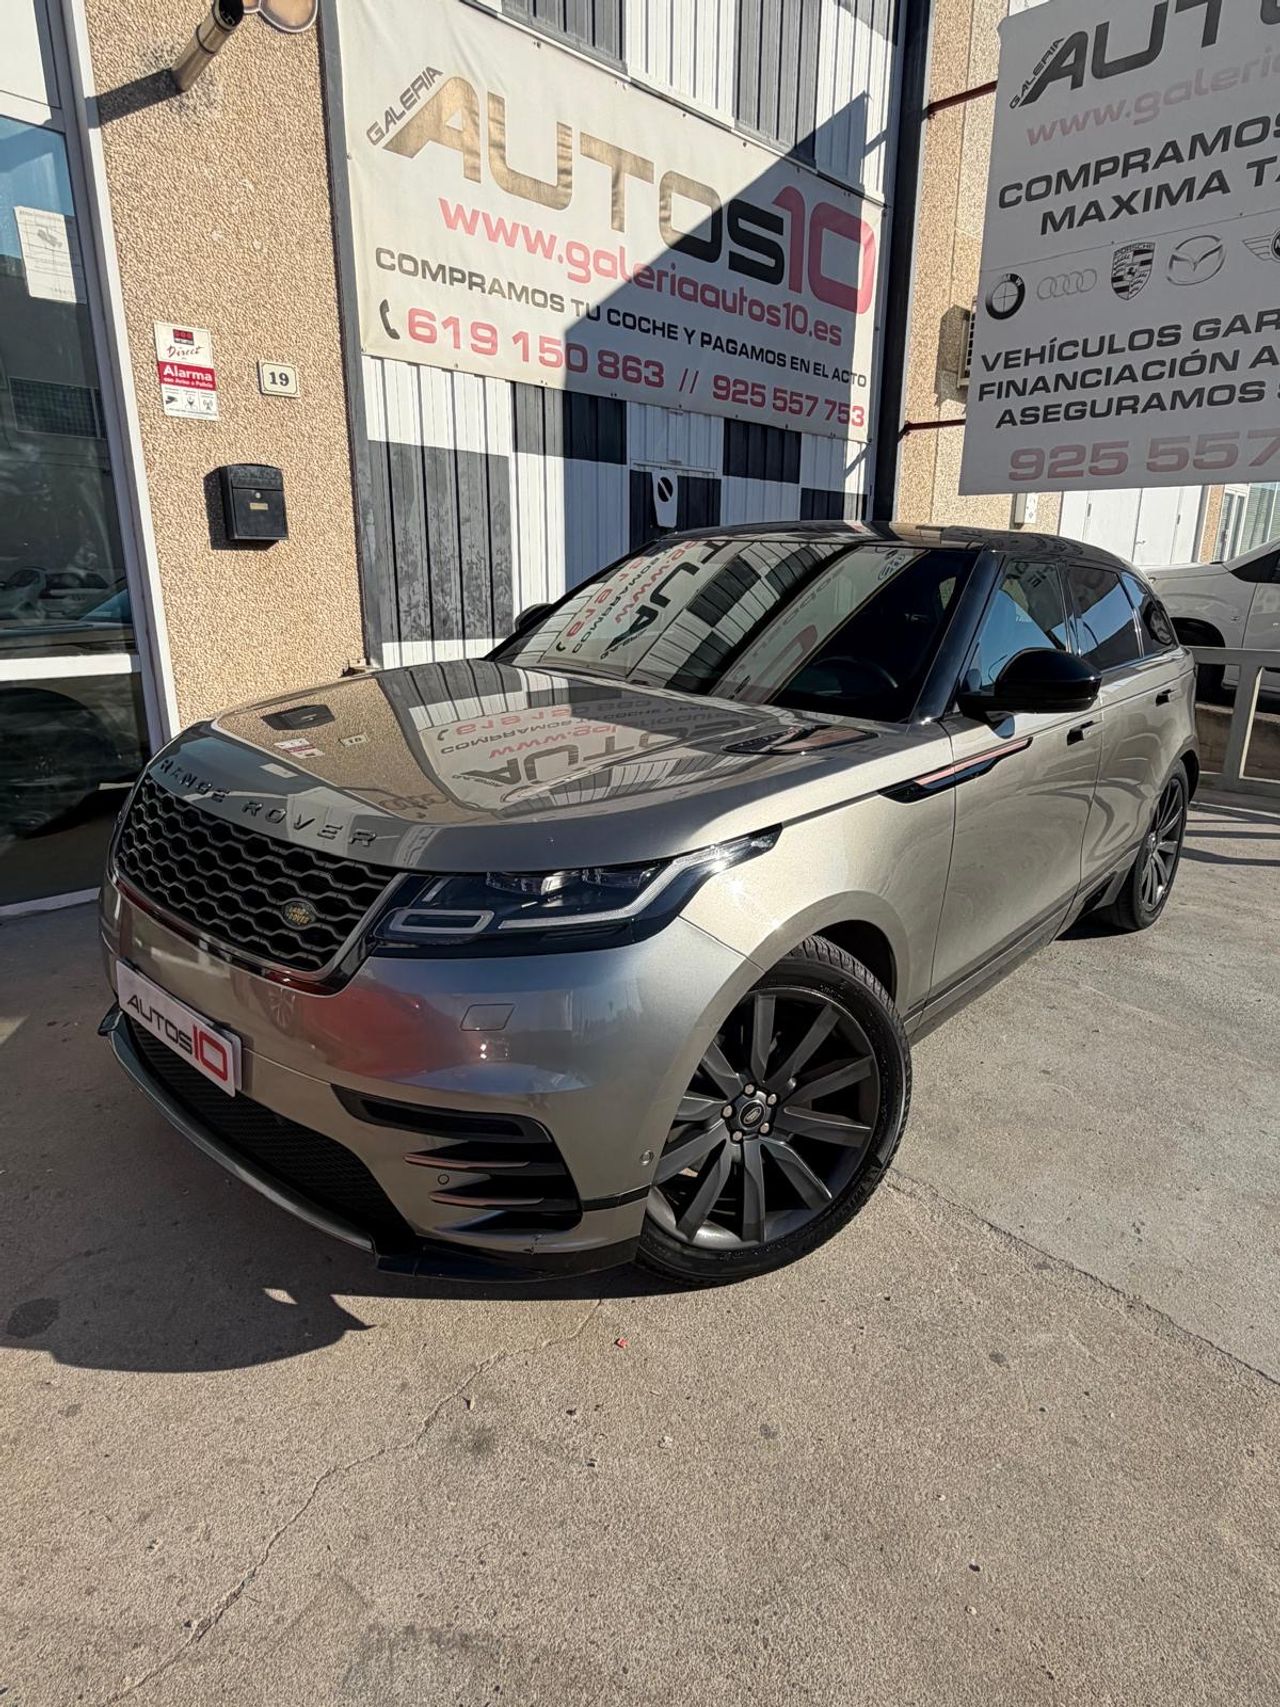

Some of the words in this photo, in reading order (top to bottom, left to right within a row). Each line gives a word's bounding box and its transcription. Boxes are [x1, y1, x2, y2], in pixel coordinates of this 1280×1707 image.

[1009, 37, 1065, 109] GALERIA
[1018, 0, 1280, 108] AUT
[366, 66, 443, 146] GALERIA
[1026, 46, 1280, 147] www.galeri
[998, 112, 1280, 209] COMPRAMO
[1040, 169, 1231, 236] MAXIMA
[1246, 155, 1280, 188] T
[438, 197, 842, 347] www.galeriaautos10.es
[167, 344, 204, 358] Direct
[375, 247, 565, 313] COMPRAMOS
[570, 298, 601, 322] TU
[606, 308, 679, 340] COCHE
[684, 328, 696, 345] Y
[700, 332, 787, 367] PAGAMOS
[790, 355, 810, 374] EN
[813, 362, 829, 378] EL
[831, 368, 868, 388] ACTO
[981, 324, 1182, 372] VEHÍCULOS
[163, 365, 213, 381] Alarma
[268, 371, 290, 387] 19
[408, 307, 498, 356] 619
[512, 331, 588, 374] 150
[597, 350, 664, 389] 863
[713, 374, 766, 409] 925
[772, 388, 819, 418] 557
[825, 400, 865, 428] 753
[978, 348, 1240, 402] FINANCIACIÓN
[995, 381, 1266, 429] ASEGURAMOS
[1008, 440, 1130, 482] 925
[1146, 428, 1280, 473] 557
[159, 758, 231, 803] RANGE
[241, 800, 377, 848] ROVER
[126, 994, 228, 1082] AUTOS10
